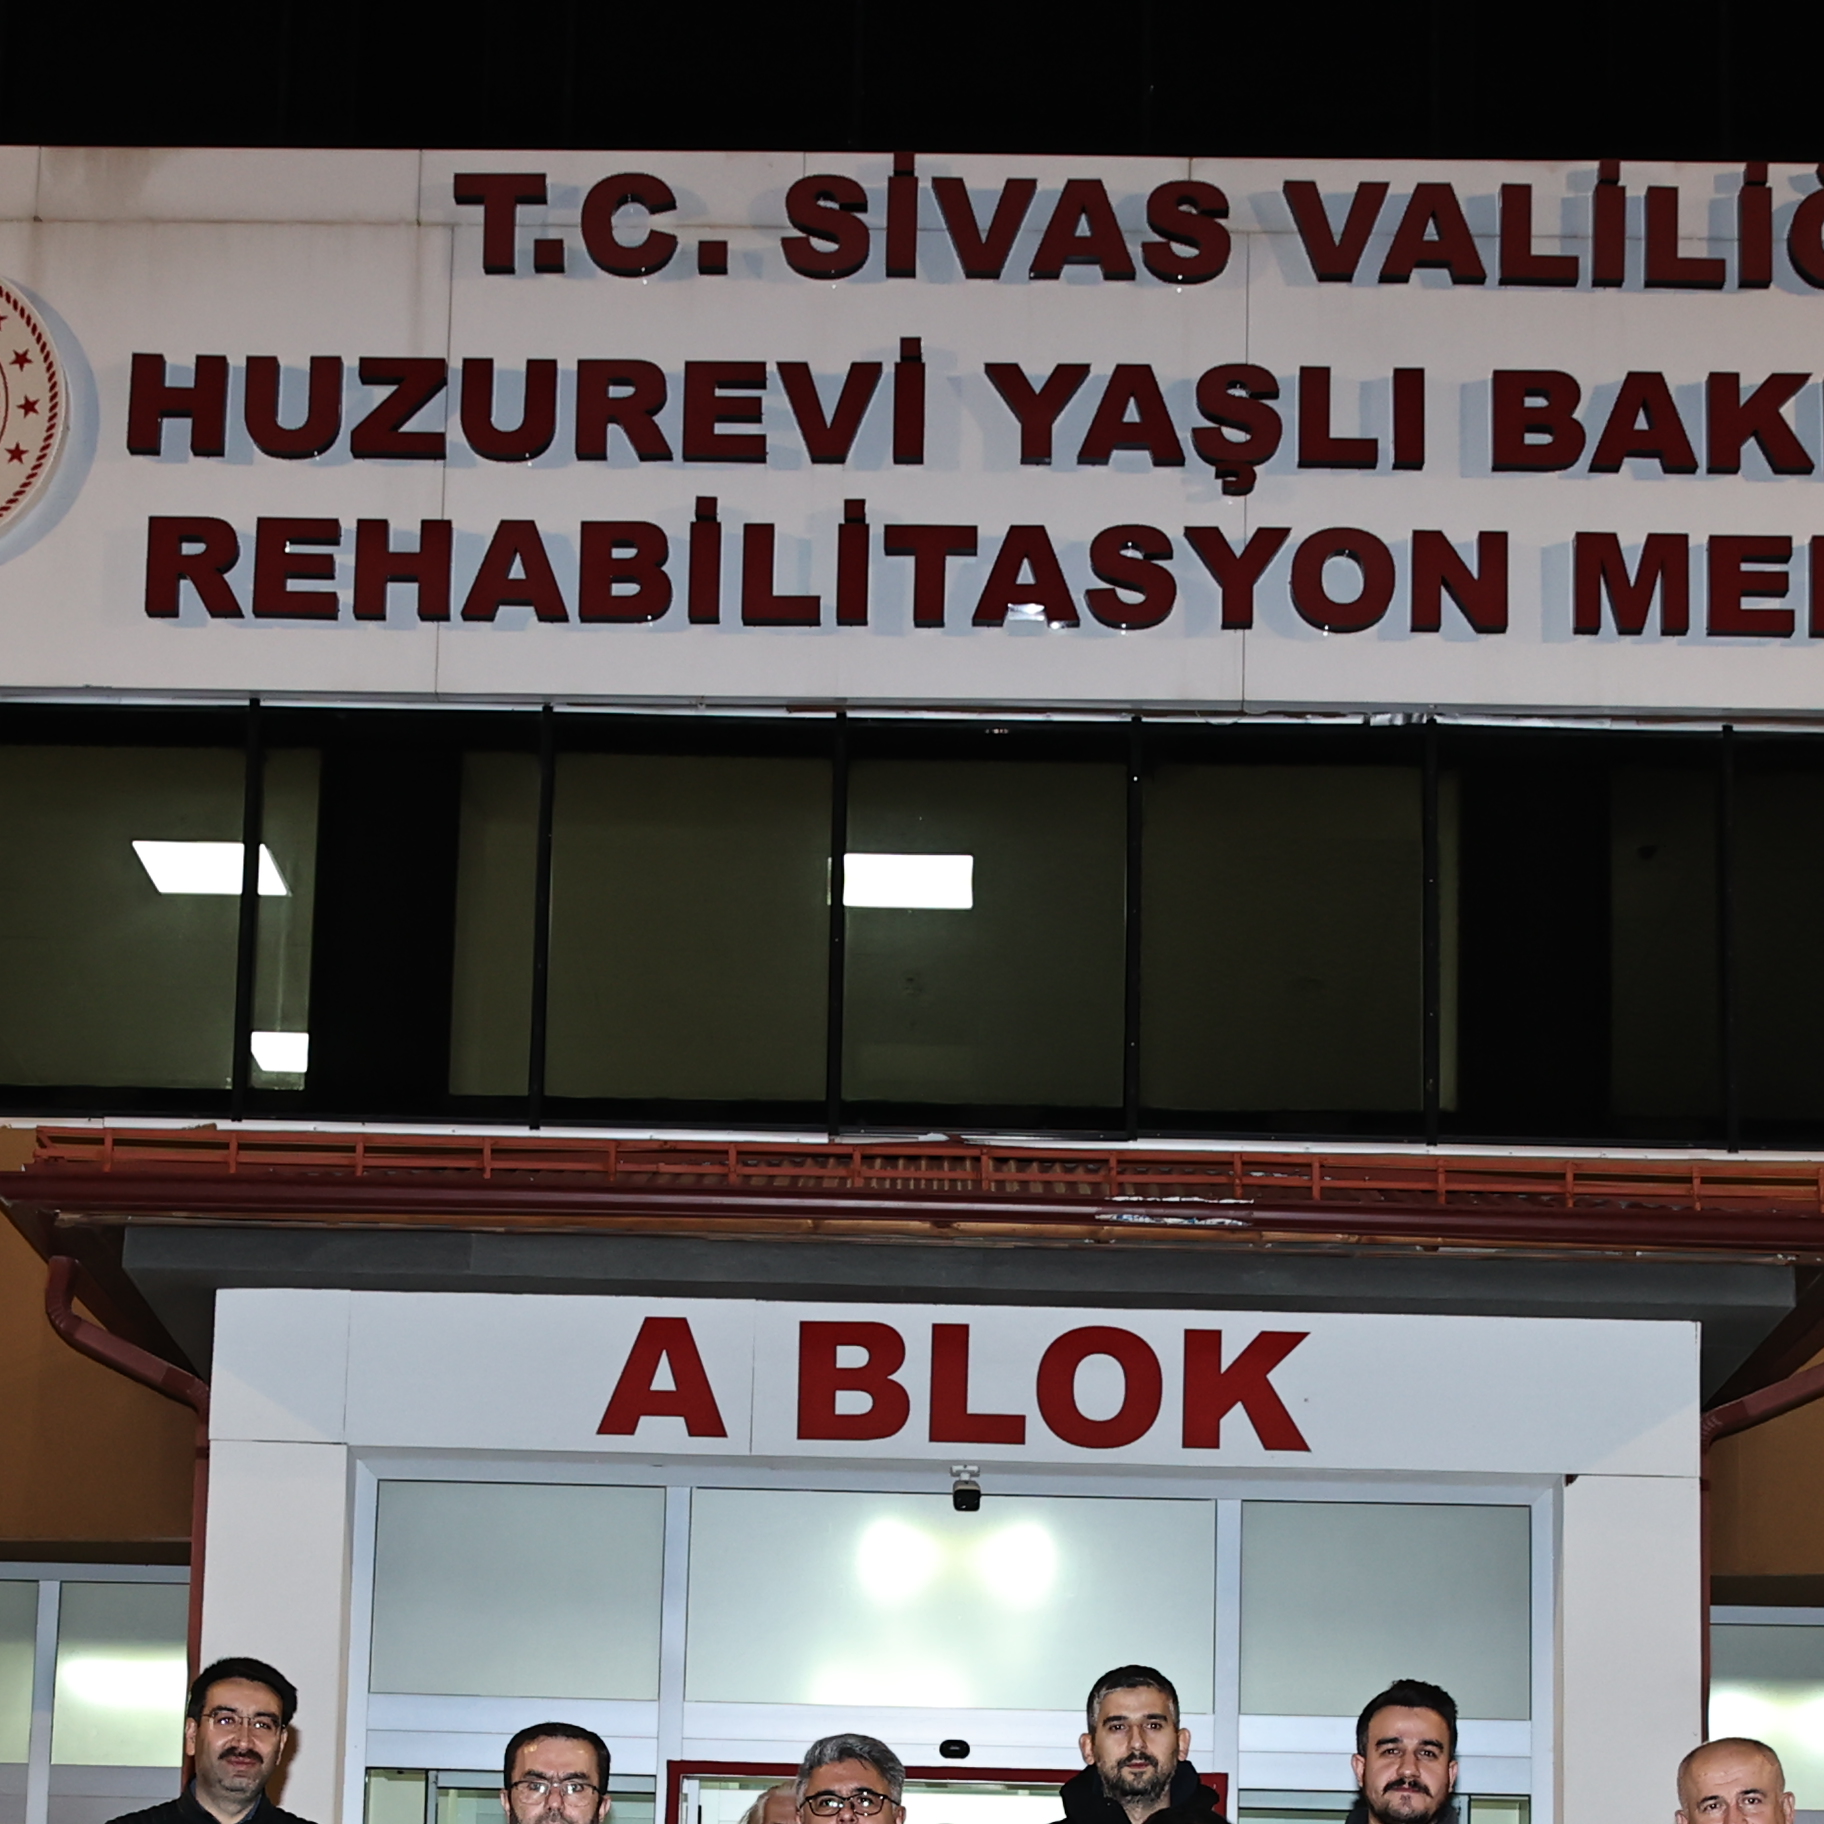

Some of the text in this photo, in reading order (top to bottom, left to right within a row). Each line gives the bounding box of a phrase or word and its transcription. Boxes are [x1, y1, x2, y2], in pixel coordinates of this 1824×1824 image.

[453, 172, 728, 278] T.C.
[780, 151, 1232, 284] SİVAS
[129, 336, 926, 467] HUZUREVİ
[985, 363, 1428, 496] YAŞLI
[146, 496, 1509, 637] REHABİLİTASYON
[599, 1316, 1309, 1451] A BLOK
